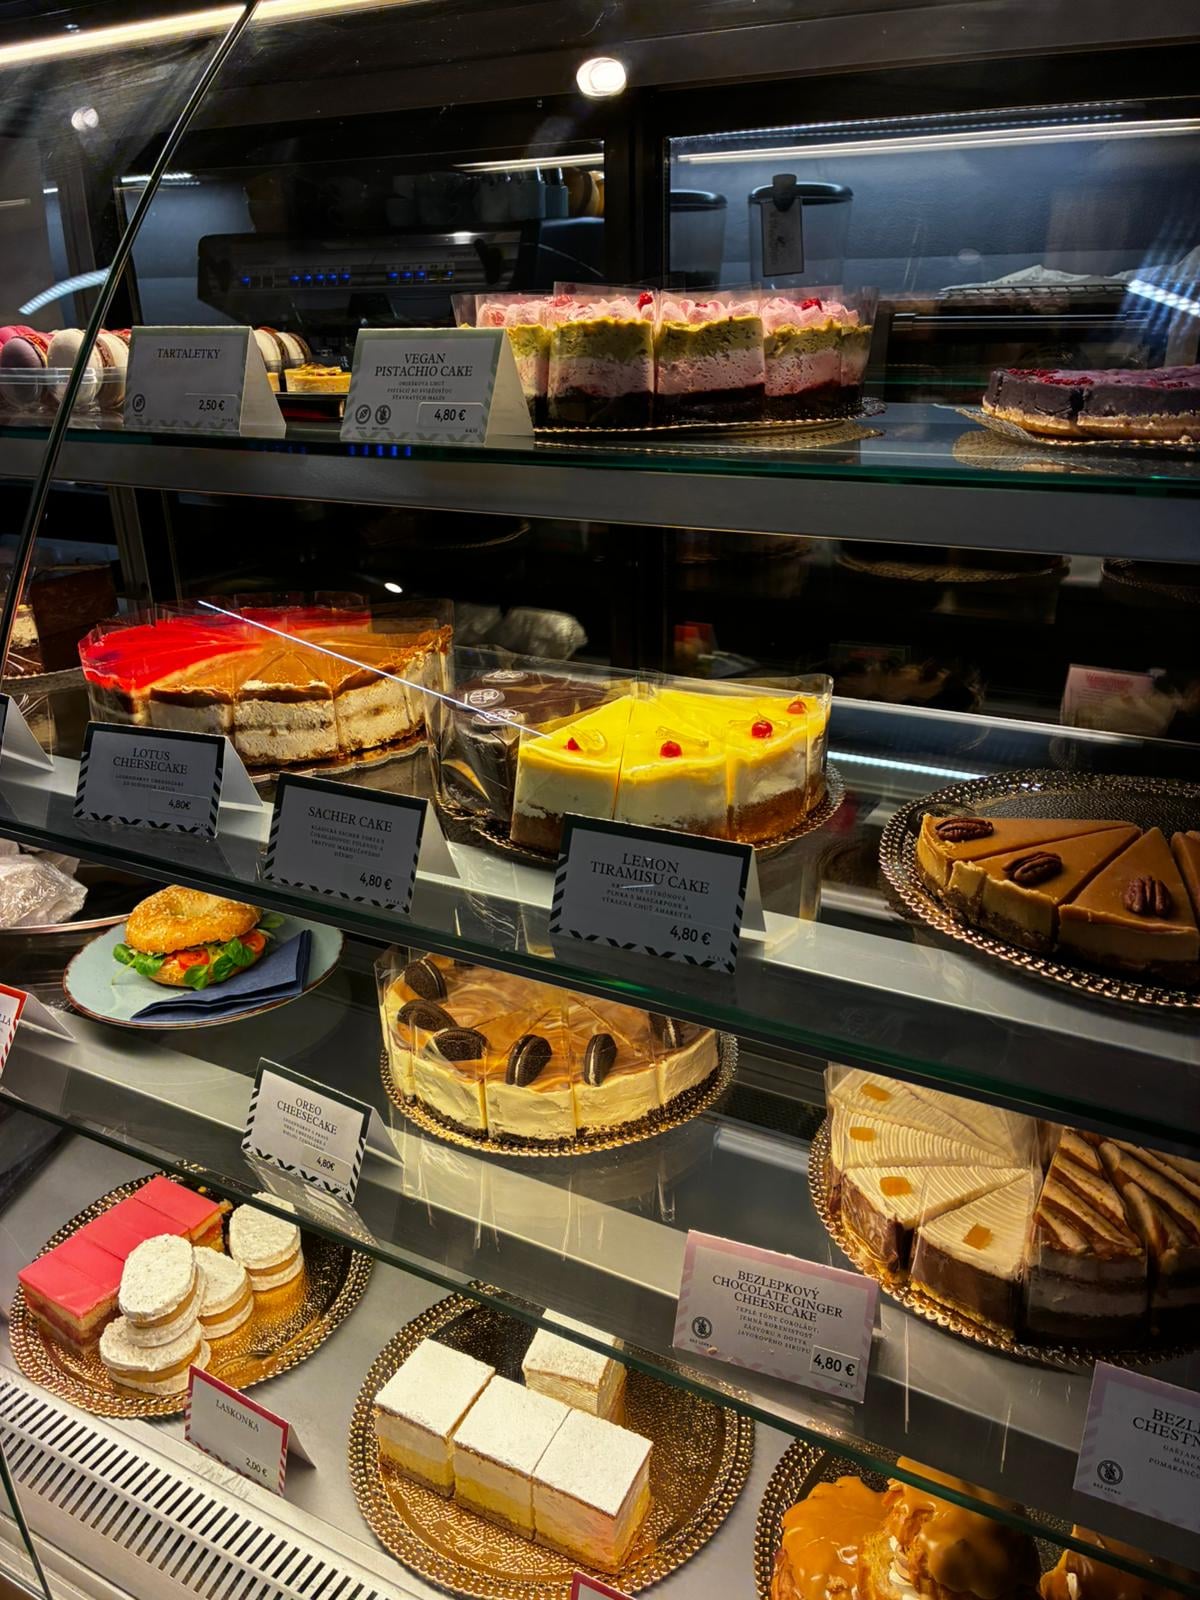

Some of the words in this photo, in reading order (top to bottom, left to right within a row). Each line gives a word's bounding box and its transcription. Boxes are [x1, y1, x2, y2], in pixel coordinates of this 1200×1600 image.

[157, 348, 220, 360] TARTALETKY
[404, 352, 446, 364] VEGAN
[375, 366, 438, 377] PISTACHIO
[440, 366, 473, 377] CAKE
[198, 400, 216, 412] 2,50
[218, 400, 225, 411] €
[434, 408, 455, 422] 4,80
[458, 409, 466, 421] €
[132, 748, 170, 760] LOTUS
[113, 756, 188, 774] CHEESECAKE
[168, 799, 192, 810] 4,80€
[308, 806, 357, 826] SACHER
[359, 816, 392, 832] CAKE
[622, 852, 680, 874] LEMON
[360, 872, 382, 888] 4,80
[384, 878, 392, 890] €
[590, 860, 664, 886] TIRAMISU
[668, 876, 710, 894] CAKE
[670, 925, 698, 943] 4,80
[701, 932, 712, 945] €
[295, 1097, 322, 1116] OREO
[277, 1100, 338, 1135] CHEESECAKE
[738, 1270, 820, 1300] BEZLEPKOVÝ
[712, 1275, 789, 1303] CHOCOLATE
[792, 1297, 843, 1318] GINGER
[734, 1292, 817, 1322] CHEESECAKE
[813, 1354, 842, 1373] 4,80
[845, 1363, 855, 1377] €
[216, 1399, 260, 1432] LASKONKA
[1152, 1408, 1200, 1434] BEZL
